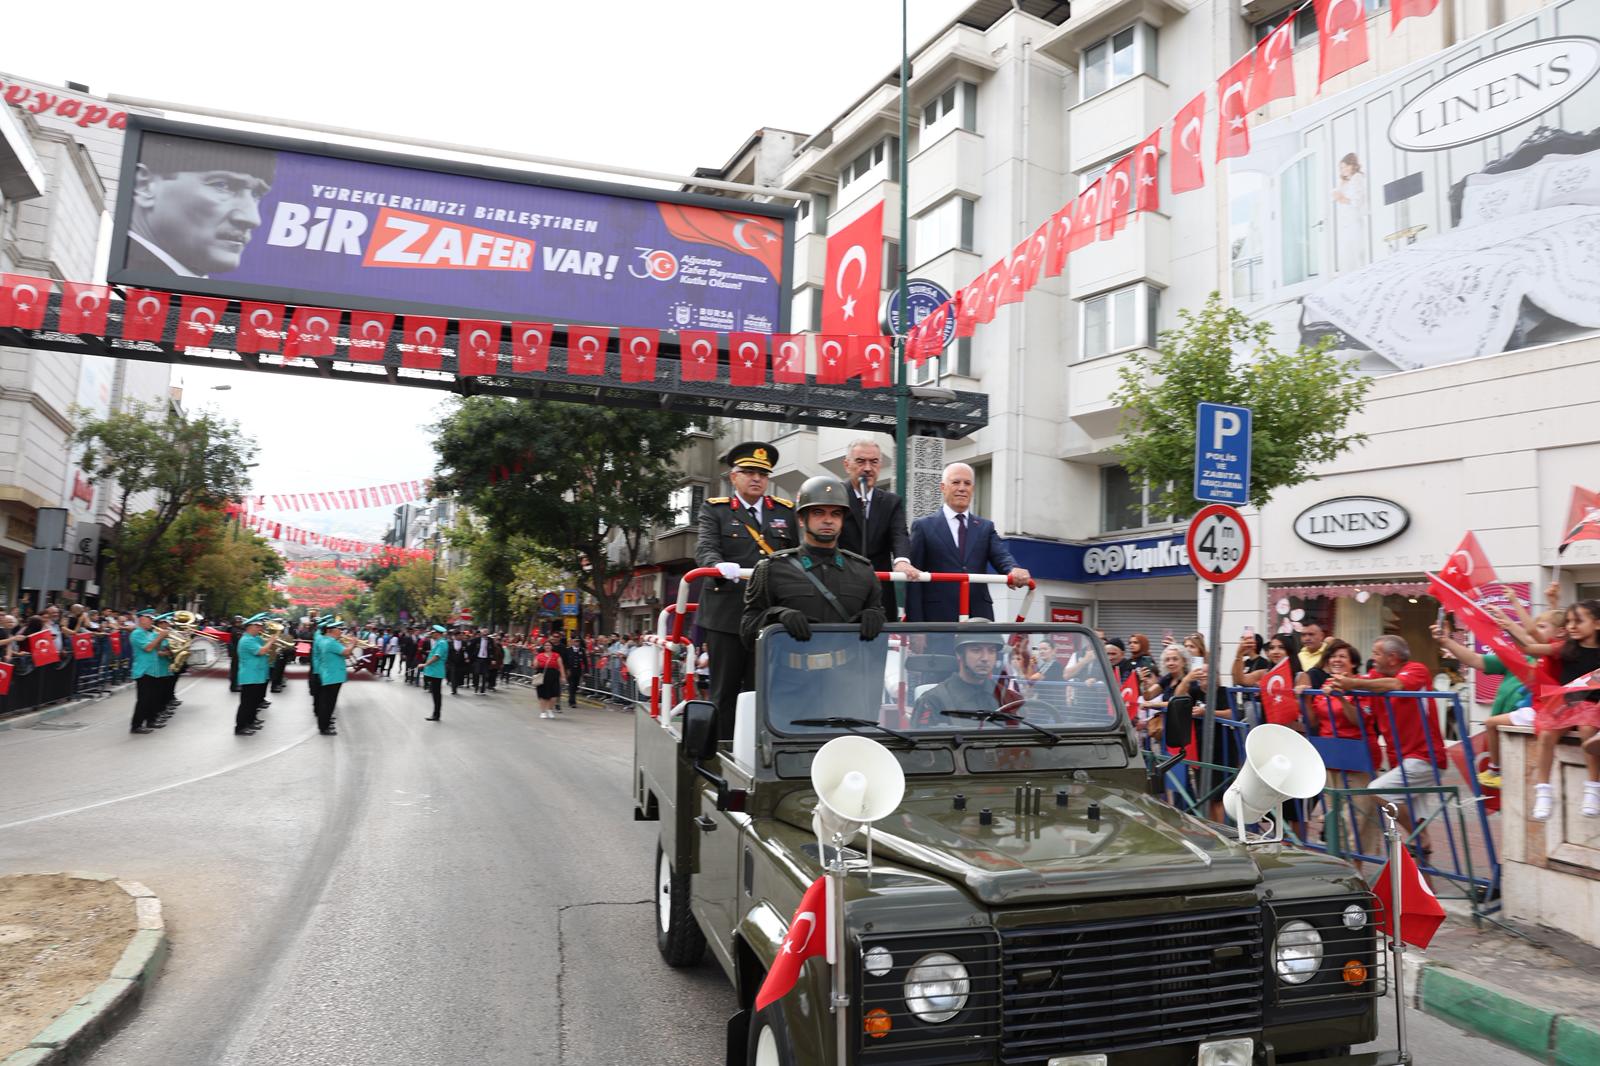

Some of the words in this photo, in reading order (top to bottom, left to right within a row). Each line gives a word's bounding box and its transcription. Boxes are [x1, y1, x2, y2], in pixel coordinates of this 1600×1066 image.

[1414, 54, 1572, 137] LINENS
[311, 184, 467, 216] YÜREKLERİMİZİ
[474, 206, 599, 233] BİRLEŞTİREN
[266, 201, 369, 256] BİR
[373, 216, 532, 269] ZAFER
[542, 246, 620, 280] VAR!
[680, 254, 723, 268] Ağustos
[680, 265, 708, 276] Zafer
[680, 275, 707, 286] Kutlu
[708, 278, 742, 290] Olsun!
[699, 307, 734, 319] BURSA
[1213, 410, 1241, 450] P
[1215, 462, 1228, 470] VE
[1308, 510, 1389, 535] LINENS
